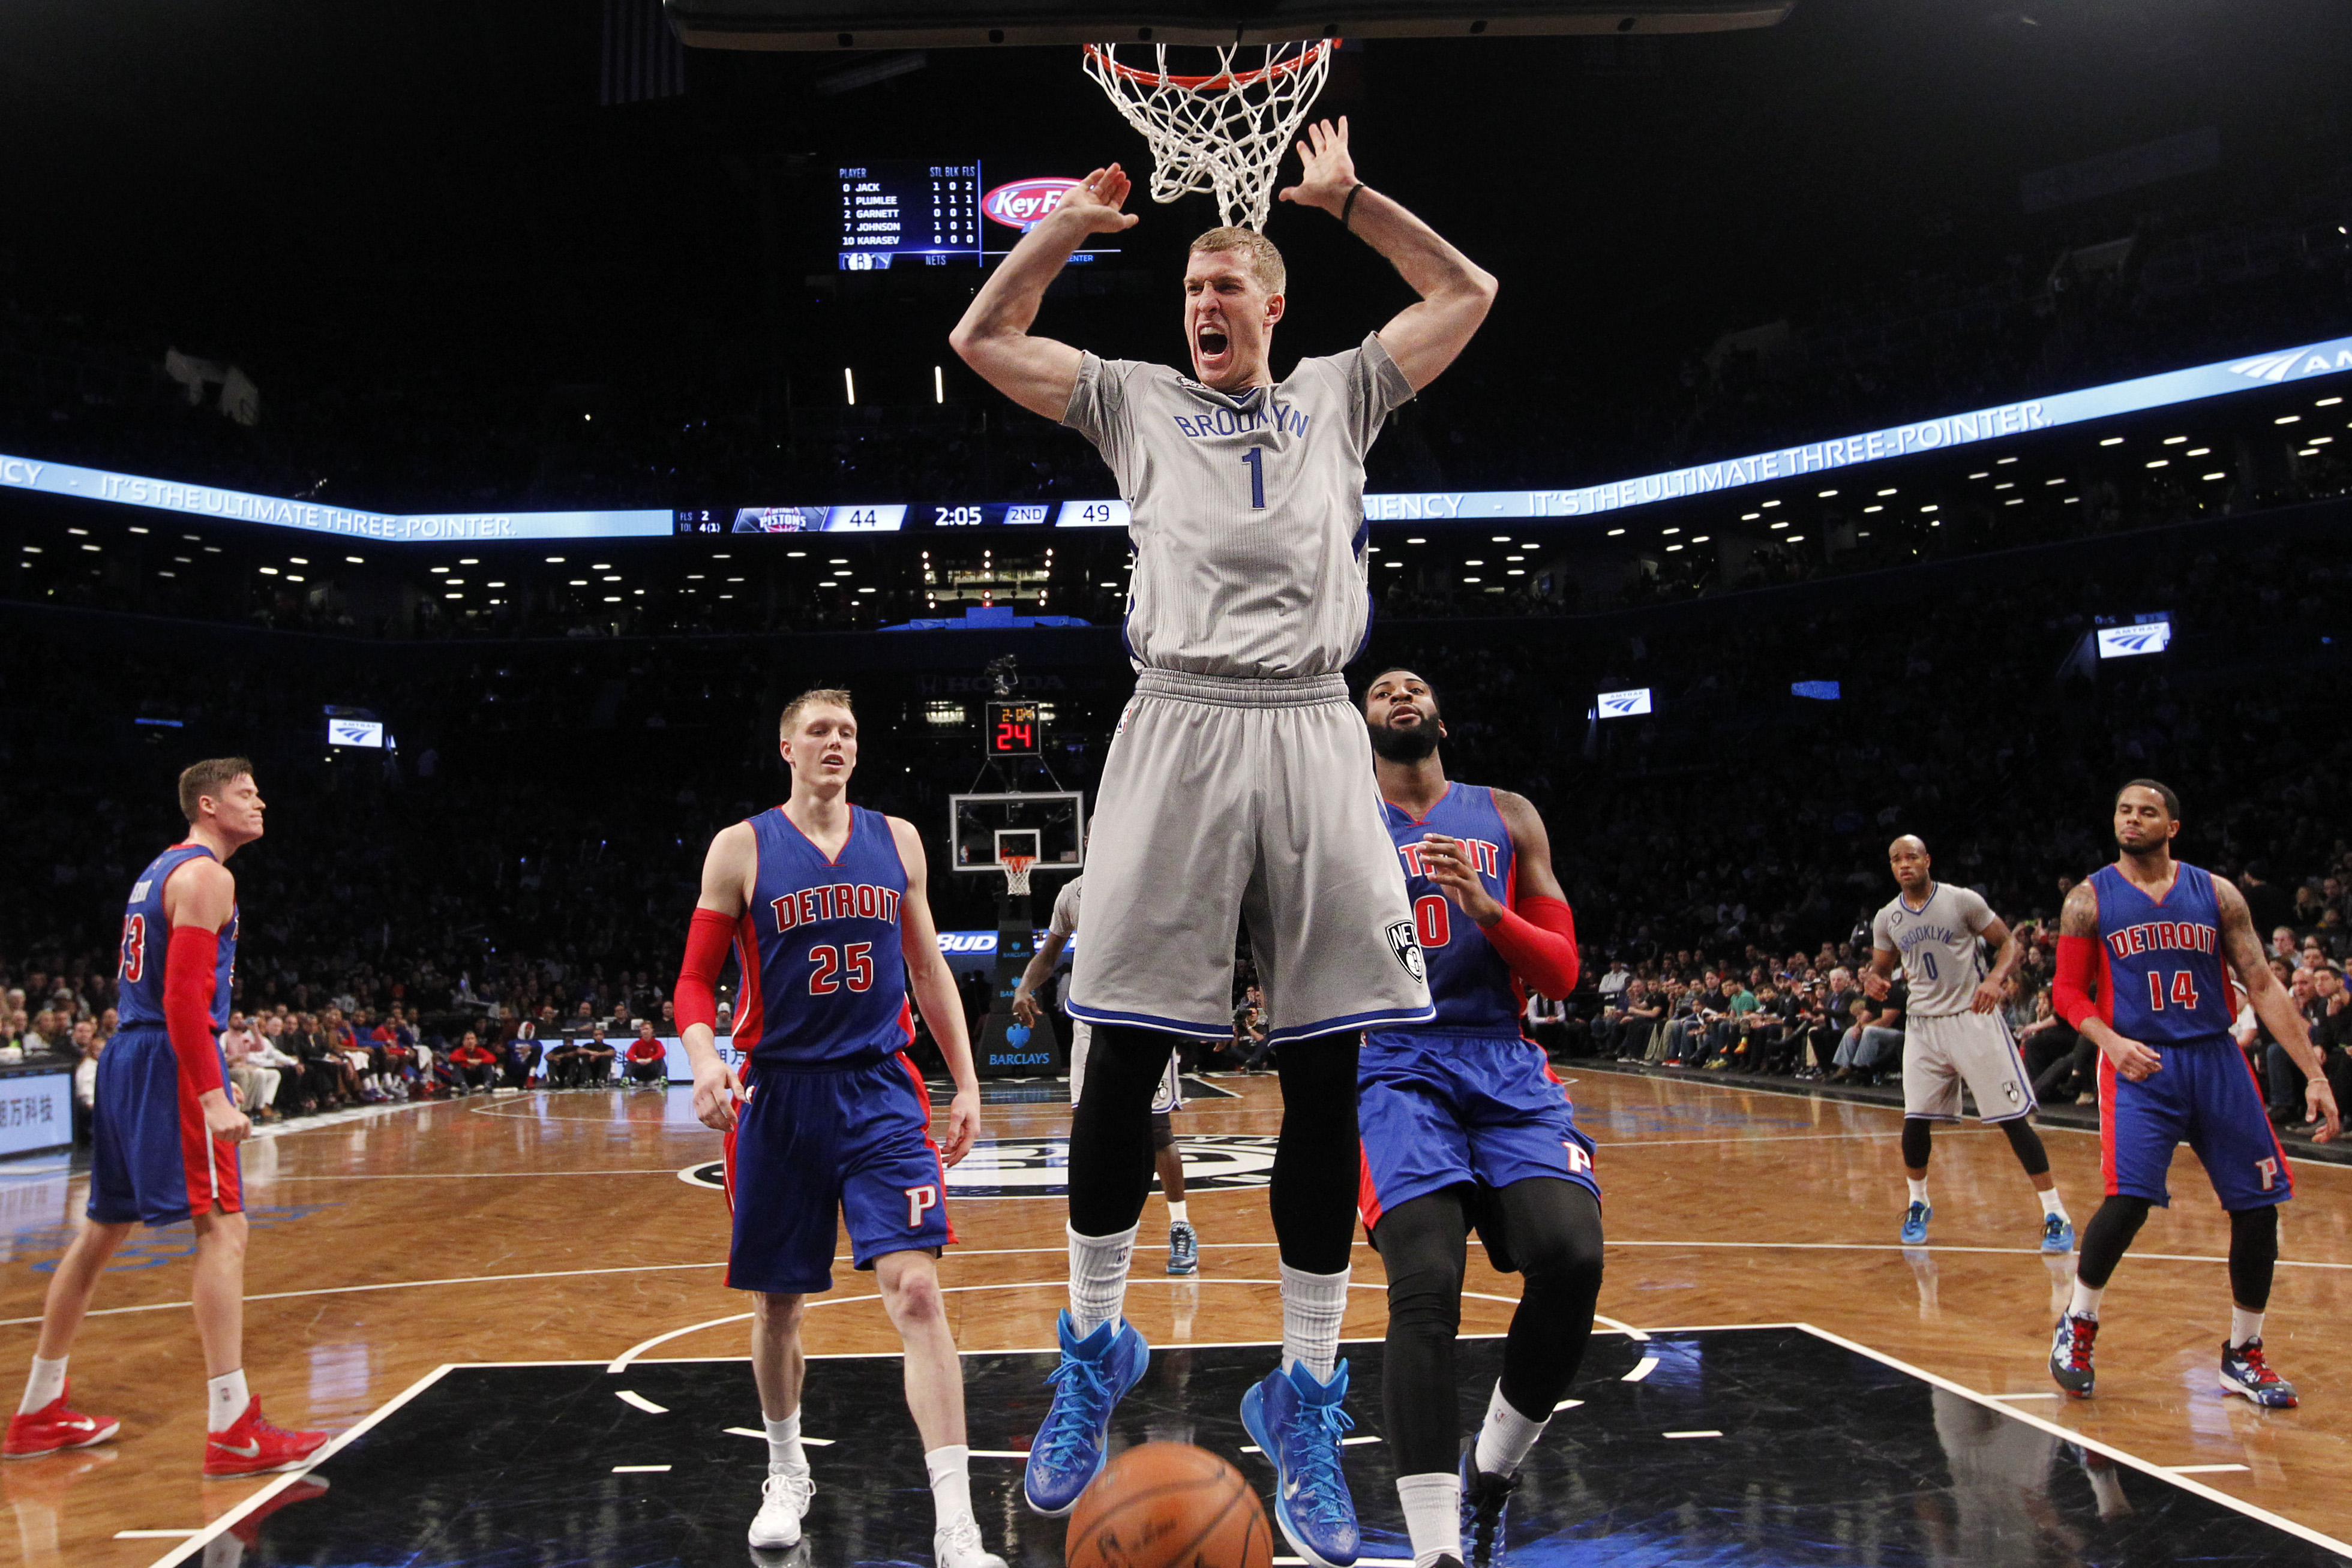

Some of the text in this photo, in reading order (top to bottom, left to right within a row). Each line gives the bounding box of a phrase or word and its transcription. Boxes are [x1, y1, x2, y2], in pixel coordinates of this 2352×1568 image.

[840, 166, 974, 178] PLAYER STL BLK FLS
[842, 182, 973, 192] 0 JACK 1 0 2
[844, 195, 973, 205] 1 PLUMLEE 1 1 1
[844, 208, 973, 218] 2 GARNETT 0 0 1
[844, 221, 973, 232] 7 JOHNSON 1 0 1
[842, 235, 973, 245] 10 KARASEV 0 0 0
[926, 256, 946, 265] NETS
[1174, 398, 1309, 438] BROOKYN
[1529, 491, 1580, 516] IT'S
[1587, 484, 1637, 511] THE
[1642, 452, 1780, 500] ULTIMATE
[1785, 400, 2053, 474] THREE-POINTER.
[1241, 447, 1265, 509] 1
[0, 457, 43, 486] CY
[101, 474, 148, 501] IT'S
[150, 483, 201, 510] THE
[206, 491, 319, 527] ULTIMATE
[323, 509, 517, 539] THREE-POINTER.
[680, 510, 709, 521] FLS 2
[758, 513, 806, 528] PISTONS
[850, 510, 877, 527] 44
[935, 506, 982, 526] 2:05
[1011, 508, 1042, 520] 2ND
[1082, 505, 1110, 522] 49
[699, 523, 721, 533] 4(1)
[2115, 625, 2160, 635] AMTRAK
[946, 675, 1067, 692] HODA
[1610, 690, 1643, 699] AMTRAK
[997, 723, 1031, 749] 24
[770, 882, 900, 934] DETROIT
[937, 933, 997, 951] BUD
[1898, 924, 1954, 953] BROOKLYN
[2107, 921, 2217, 960] DETROIT
[809, 941, 874, 996] 25
[1922, 951, 1939, 981] 0
[2147, 970, 2198, 1011] 14
[989, 1053, 1049, 1065] BARCLAYS
[1561, 1141, 1592, 1174] P
[2255, 1155, 2278, 1191] P
[904, 1183, 938, 1228] P
